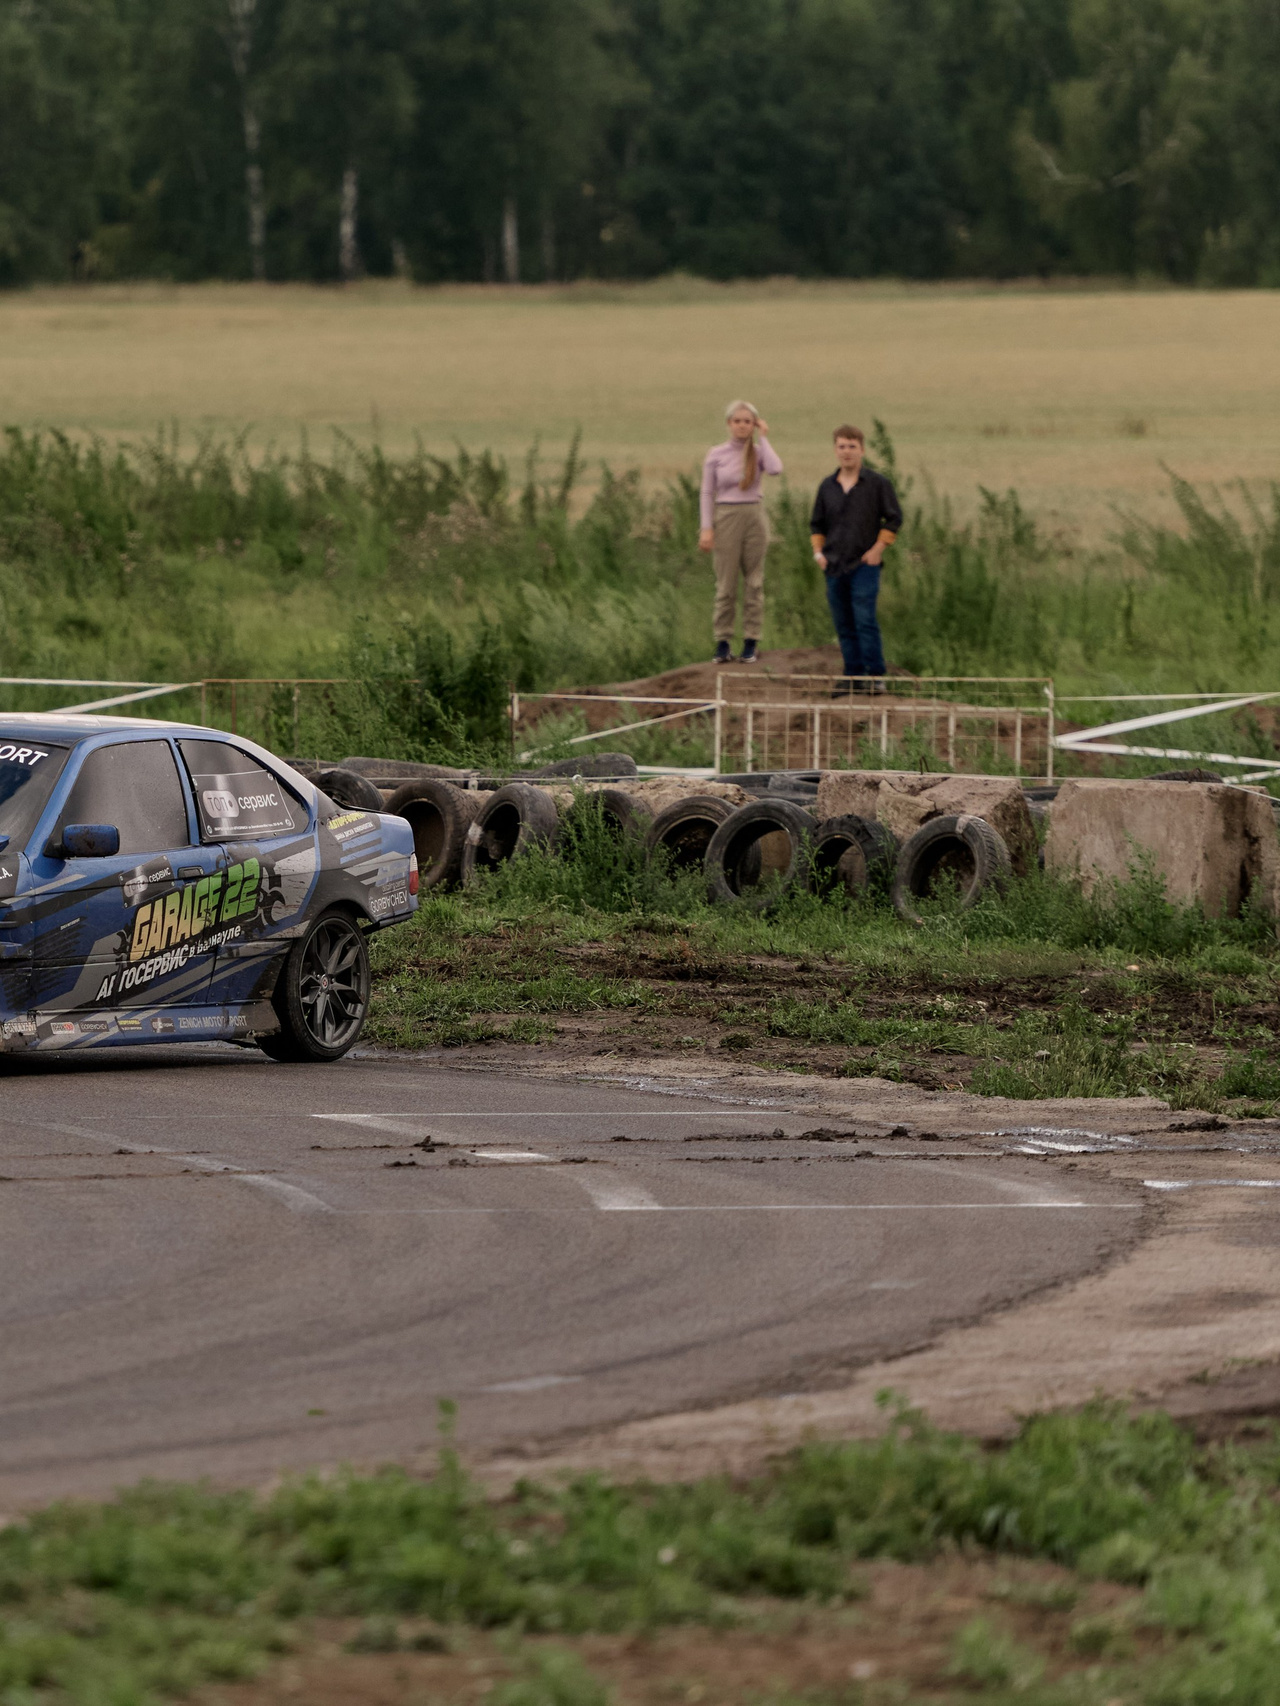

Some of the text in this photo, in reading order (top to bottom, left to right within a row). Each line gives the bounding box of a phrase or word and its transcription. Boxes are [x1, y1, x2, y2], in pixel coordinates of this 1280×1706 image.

[238, 793, 278, 811] сервис
[148, 867, 171, 882] сервис
[130, 857, 260, 962] GARAGE 22
[178, 1017, 202, 1028] ZENICH
[202, 1016, 247, 1027] MOTOPORT
